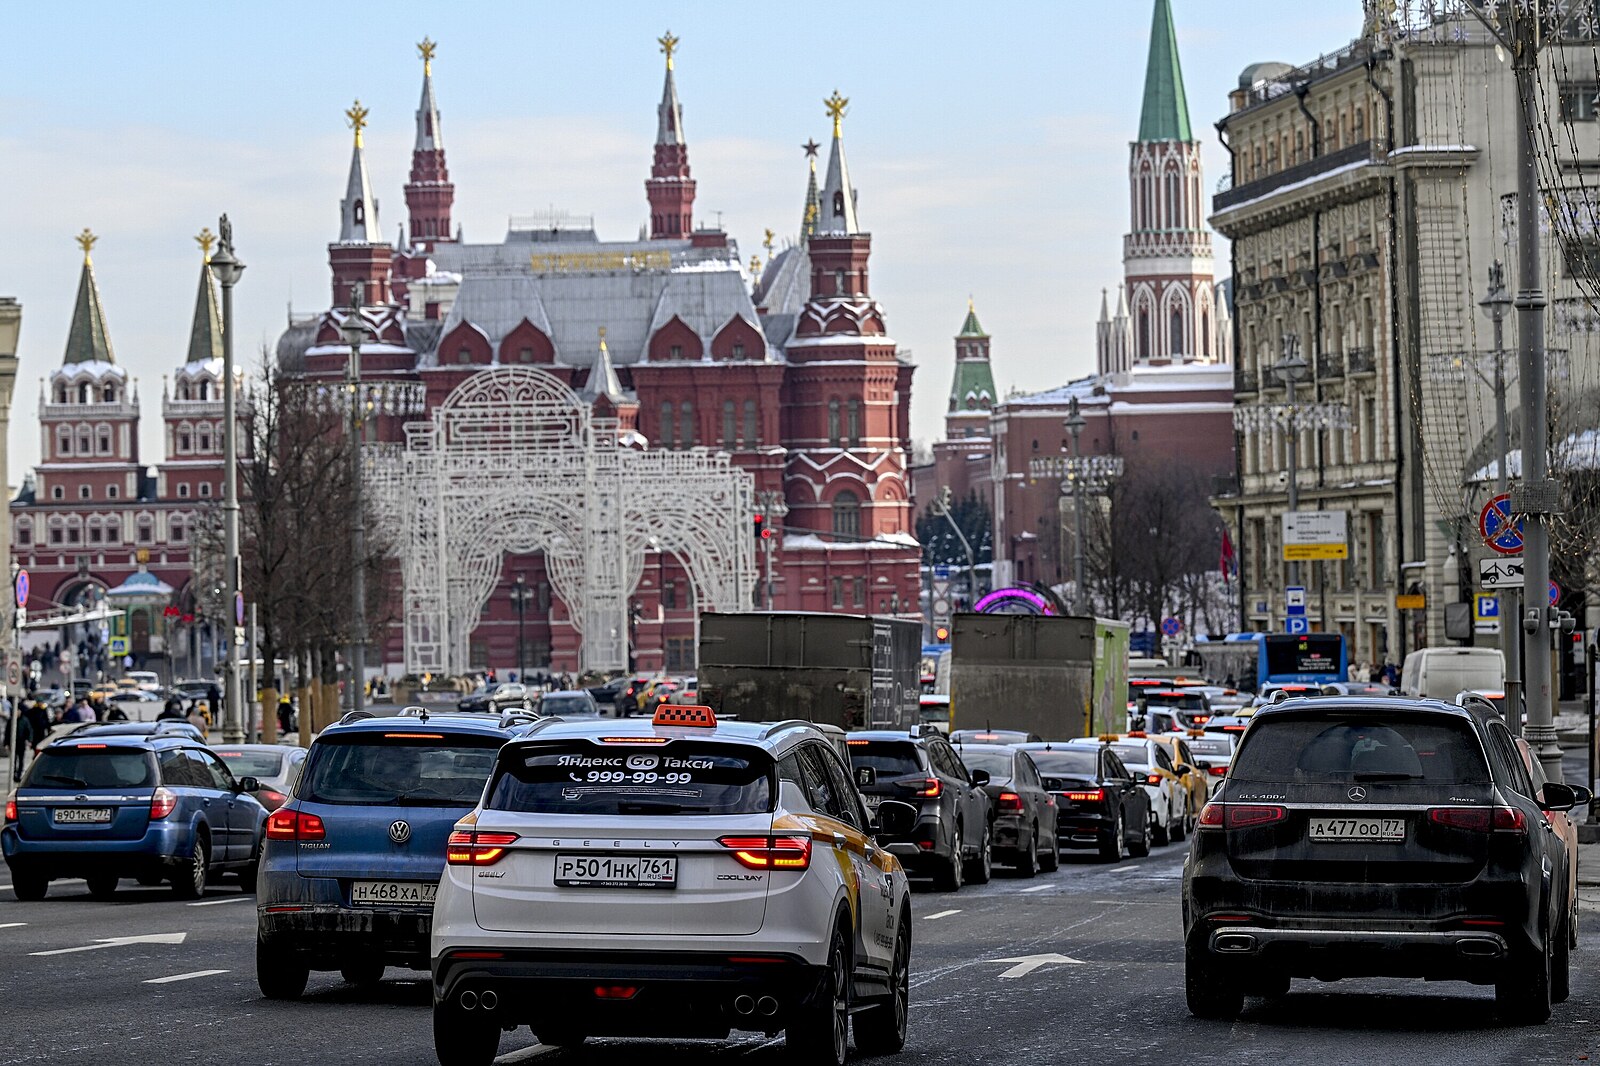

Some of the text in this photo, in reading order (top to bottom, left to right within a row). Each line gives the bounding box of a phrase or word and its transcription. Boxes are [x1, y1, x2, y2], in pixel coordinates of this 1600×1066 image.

[557, 755, 714, 769] Яндекс Go Такси
[586, 770, 692, 784] 999-99-99
[1383, 820, 1399, 832] 77
[552, 840, 681, 848] GEELY
[477, 871, 506, 879] GEELY
[562, 859, 670, 878] Р501НК 761
[358, 883, 419, 900] Н468ХА
